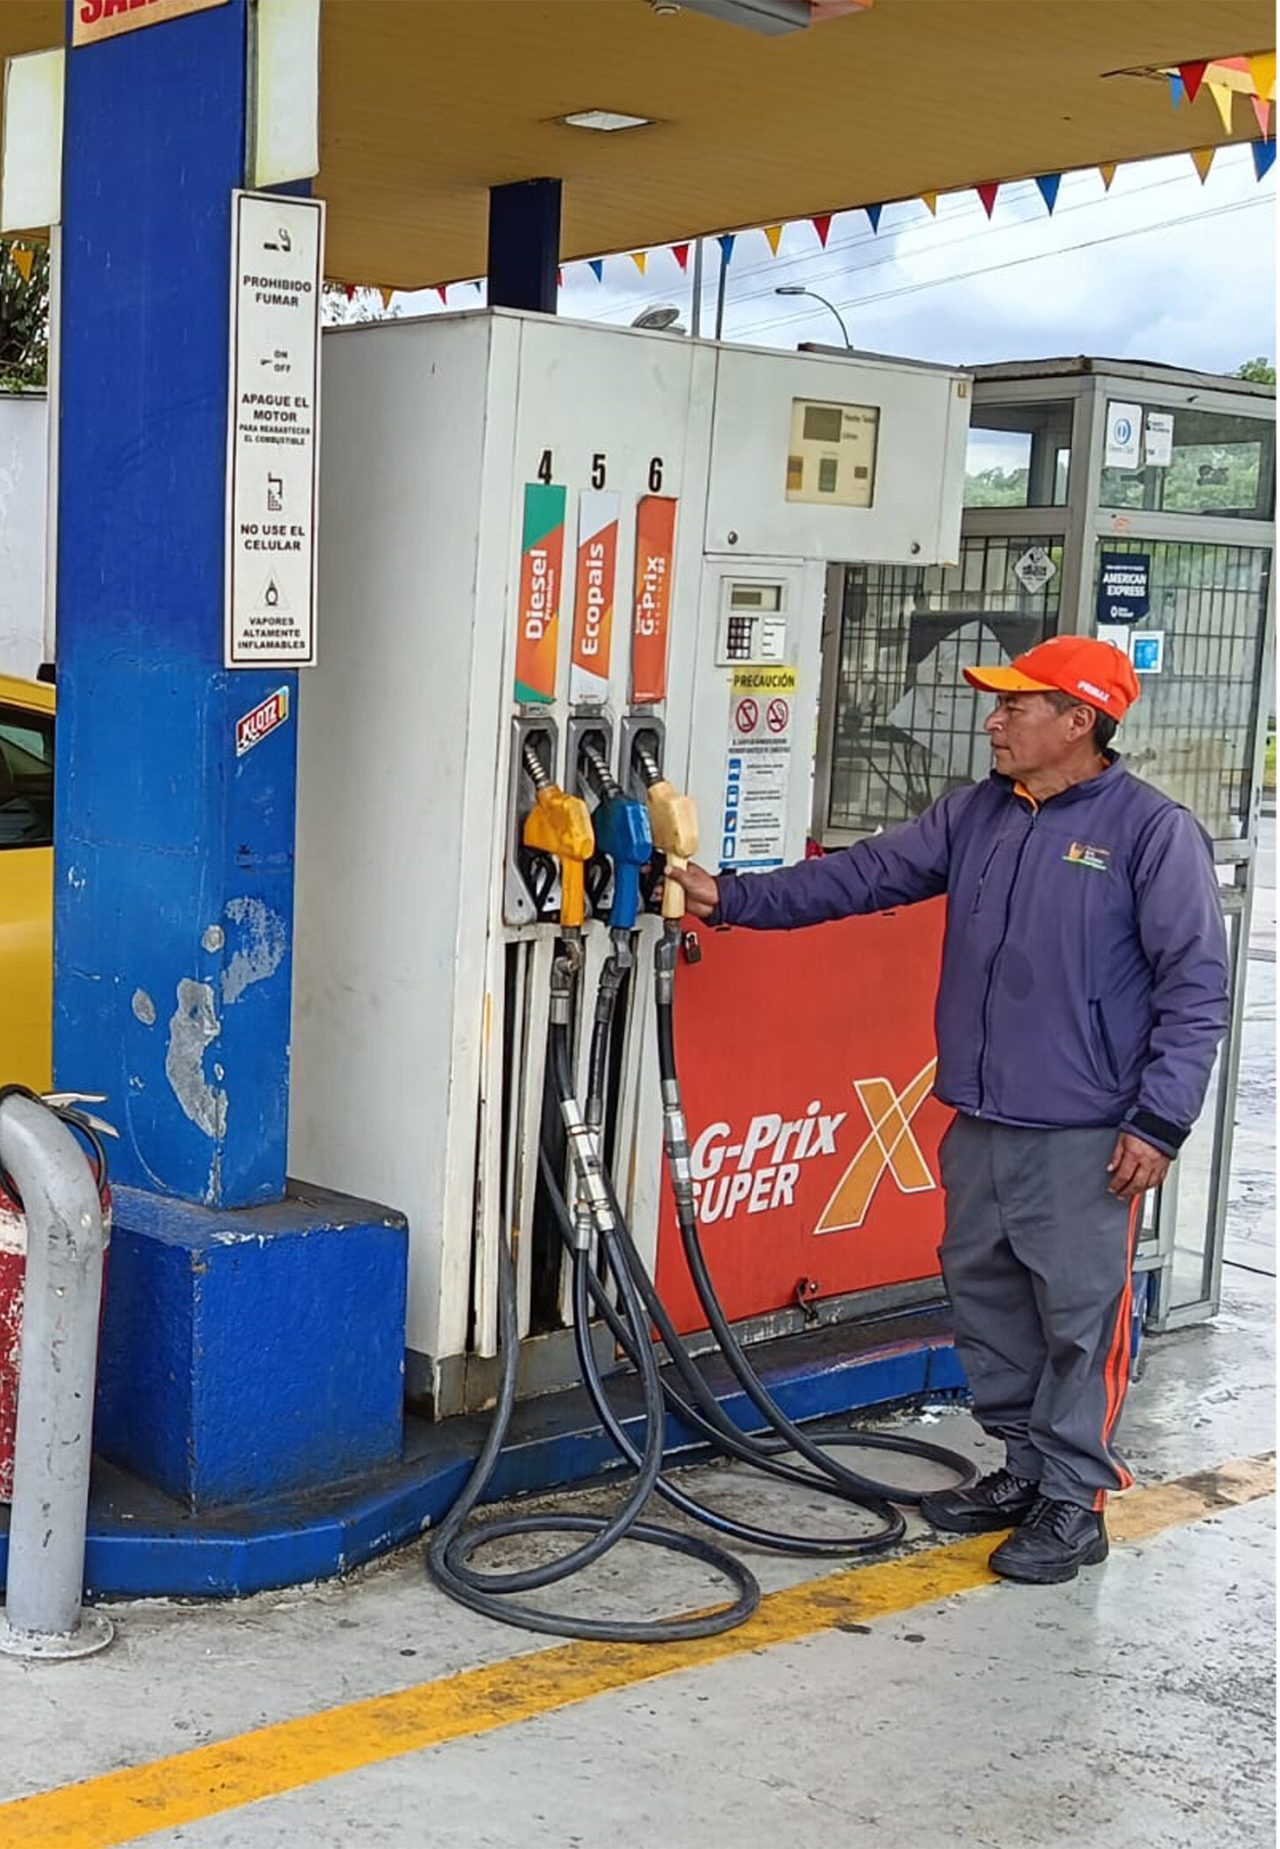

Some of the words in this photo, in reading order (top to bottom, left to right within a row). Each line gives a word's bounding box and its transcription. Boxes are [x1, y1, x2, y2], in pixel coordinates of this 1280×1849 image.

[243, 275, 312, 292] PROHIBIDO
[255, 293, 299, 306] FUMAR
[274, 350, 288, 359] ON
[274, 364, 291, 373] OFF
[241, 393, 291, 408] APAGUE
[294, 396, 310, 408] EL
[253, 410, 297, 422] MOTOR
[239, 424, 258, 432] PARA
[260, 425, 310, 435] REABASTECER
[244, 435, 253, 443] EL
[255, 436, 305, 446] COMBUSTIBLE
[537, 449, 553, 485] 4
[592, 453, 606, 490] 5
[649, 457, 663, 493] 6
[240, 524, 259, 535] NO
[262, 525, 287, 536] USE
[290, 526, 305, 537] EL
[244, 539, 301, 551] CELULAR
[1102, 572, 1147, 585] AMERICAN
[525, 549, 547, 639] Diesel
[640, 556, 659, 636] G-Prix
[1106, 584, 1146, 597] EXPRESS
[249, 617, 294, 626] VAPORES
[243, 629, 301, 638] ALTAMENTE
[238, 641, 305, 650] INFLAMABLES
[733, 673, 795, 688] PRECAUCIÓN
[689, 1100, 848, 1181] G-Prix
